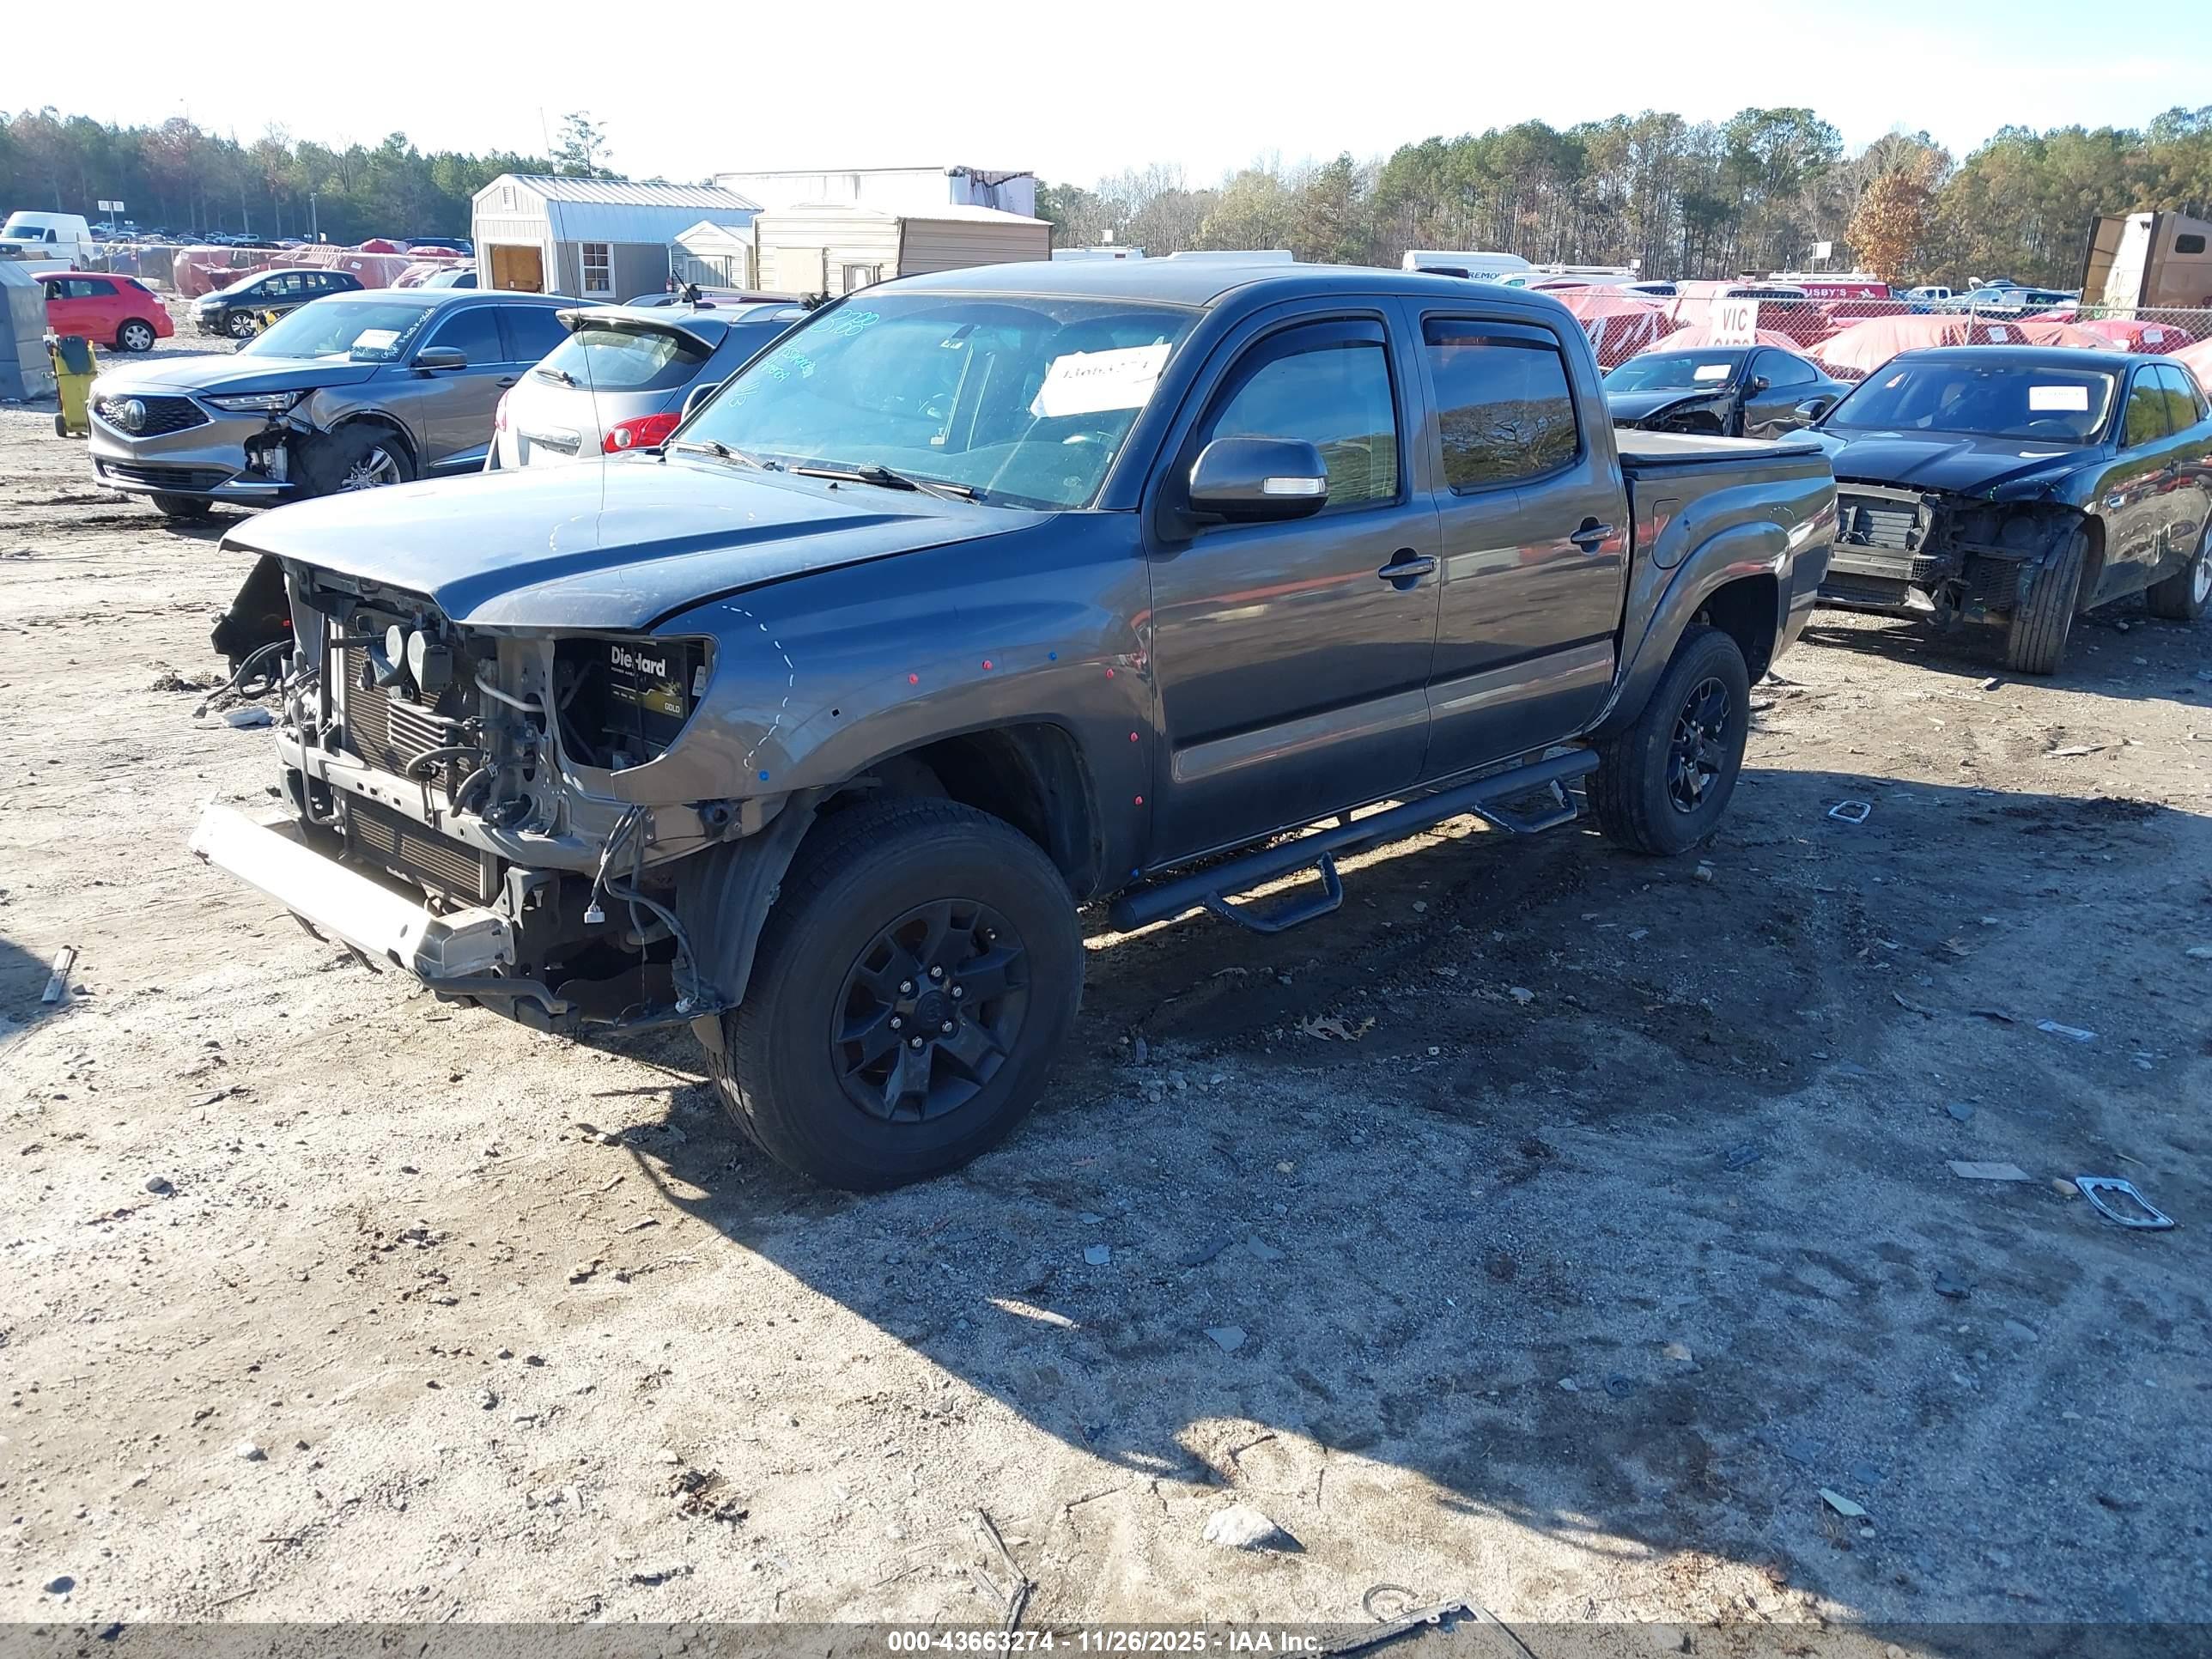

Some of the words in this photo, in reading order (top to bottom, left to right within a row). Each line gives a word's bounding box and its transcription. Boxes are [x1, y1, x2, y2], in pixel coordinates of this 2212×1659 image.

[1723, 307, 1748, 331] VIC
[611, 645, 667, 678] DieHard
[664, 702, 681, 714] GOLD
